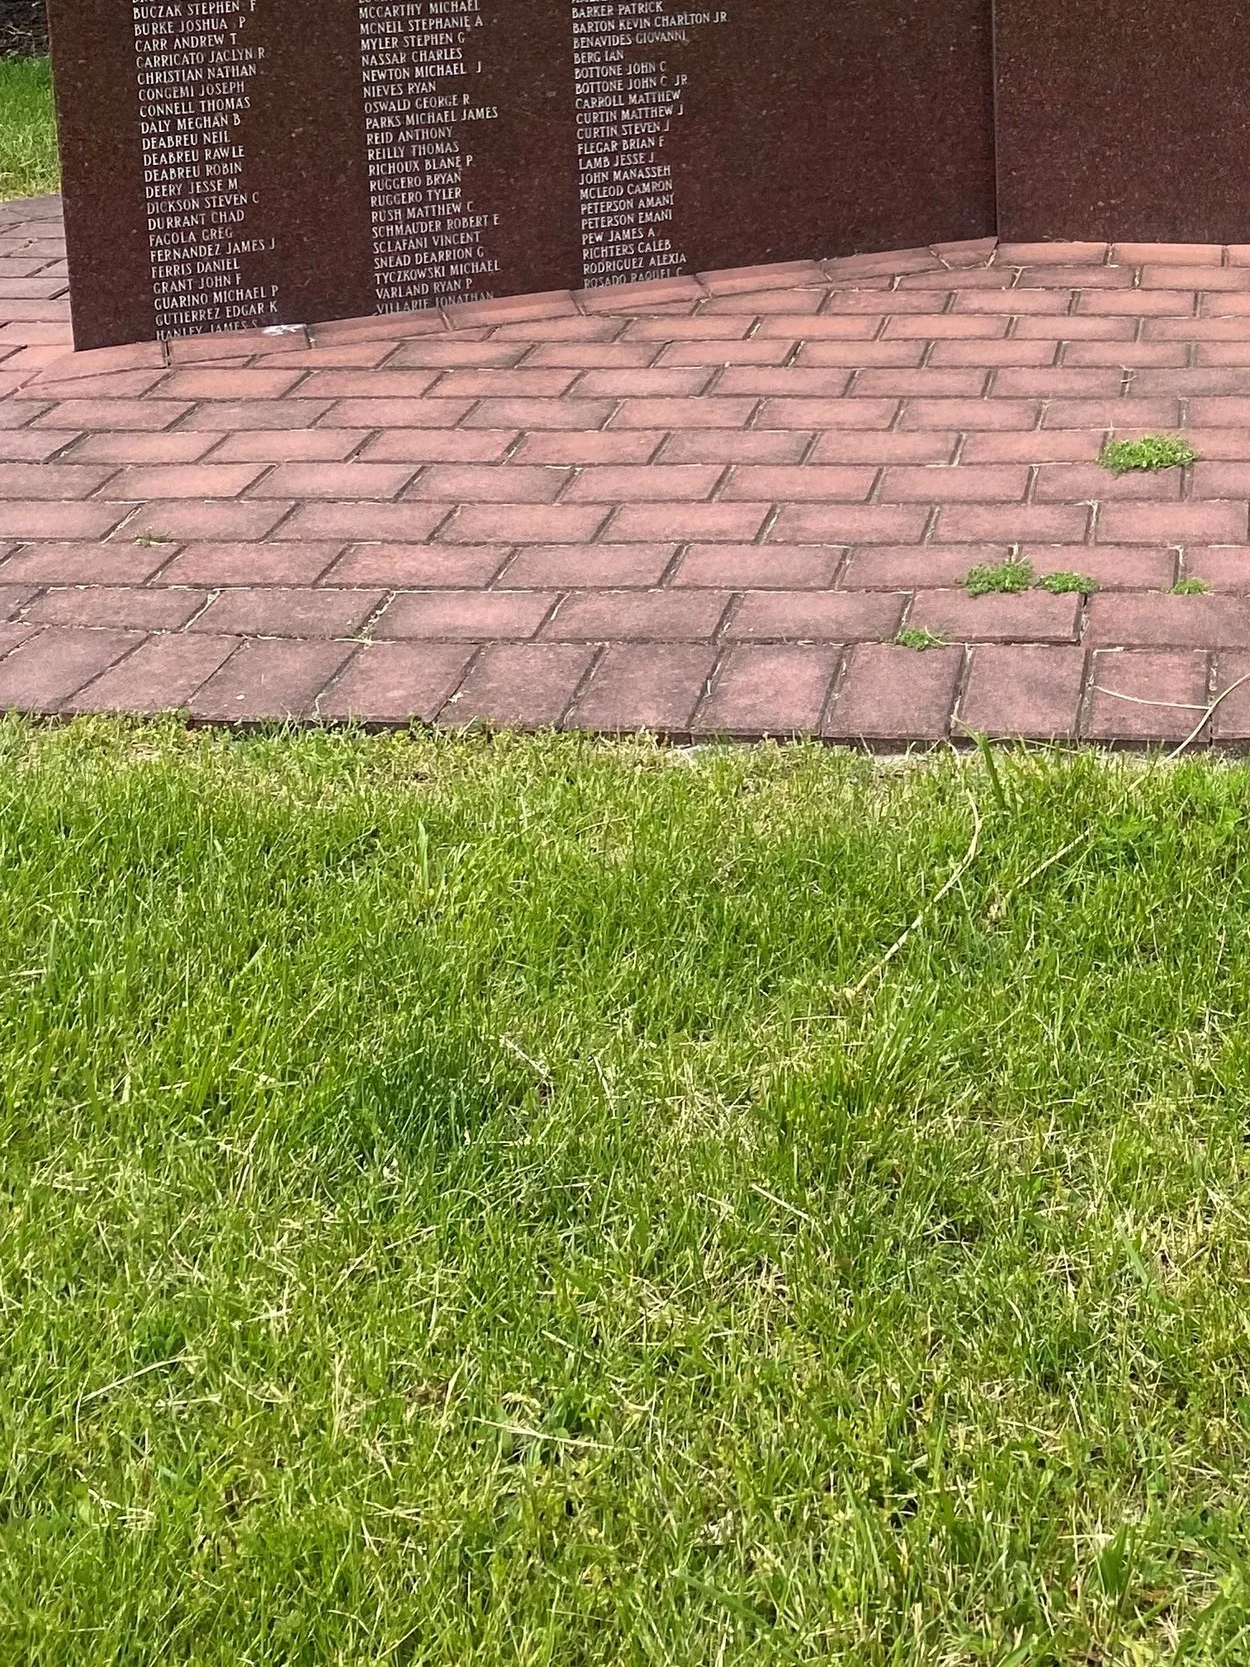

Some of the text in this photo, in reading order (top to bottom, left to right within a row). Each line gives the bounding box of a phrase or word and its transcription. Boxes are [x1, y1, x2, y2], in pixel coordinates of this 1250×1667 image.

[359, 0, 481, 19] MCCARTHY MICHAEL
[572, 1, 664, 19] BARKER PATRICK
[573, 12, 728, 34] BARTON KEVIN CHARLTON JR
[135, 33, 237, 52] CARR ANDREW T
[574, 30, 687, 49] BENAVIDES GIOVANNI
[362, 47, 462, 67] NASSAR CHARLES
[574, 50, 624, 64] BERG IAN
[137, 64, 257, 84] CHRISTIAN NATHAN
[363, 61, 482, 83] NEWTON MICHAEL J
[138, 81, 245, 101] CONGEMI JOSEPH
[363, 81, 436, 98] NIEVES RYAN
[576, 89, 681, 110] CARROLL MATTHEW
[140, 97, 251, 117] CONNELL THOMAS
[576, 104, 684, 125] CURTIN MATTHEW J
[366, 106, 499, 130] PARKS MICHAEL JAMES
[142, 131, 231, 151] DEABREU NEIL
[367, 126, 454, 145] REID ANTHONY
[143, 145, 245, 166] DEABREU RAWLE
[368, 141, 460, 161] REILLY THOMAS
[144, 162, 242, 183] DEABREU ROBIN
[370, 173, 462, 192] RUGGERO BRYAN
[579, 165, 671, 186] JOHN MANASSEH
[147, 192, 259, 215] DICKSON STEVEN C
[371, 187, 462, 208] RUGGERO TYLER
[580, 185, 624, 201] MCLEOD
[581, 194, 676, 215] PETERSON AMANI
[148, 210, 245, 231] DURRANT CHAD
[372, 213, 499, 239] SCHMAUDER ROBERT E
[582, 209, 672, 230] PETERSON EMANI
[202, 227, 233, 241] GREG
[373, 231, 481, 254] SCLAFANI VINCENT
[582, 227, 655, 245] PEW JAMES A
[583, 239, 671, 260] RICHTERS CALEB
[152, 258, 240, 279] FERRIS DANIEL
[375, 260, 500, 285] TYCZKOWSKI MICHAEL
[583, 253, 687, 275] RODRIGUEZ ALEXIA
[155, 301, 278, 327] GUTIERREZ EDGAR K
